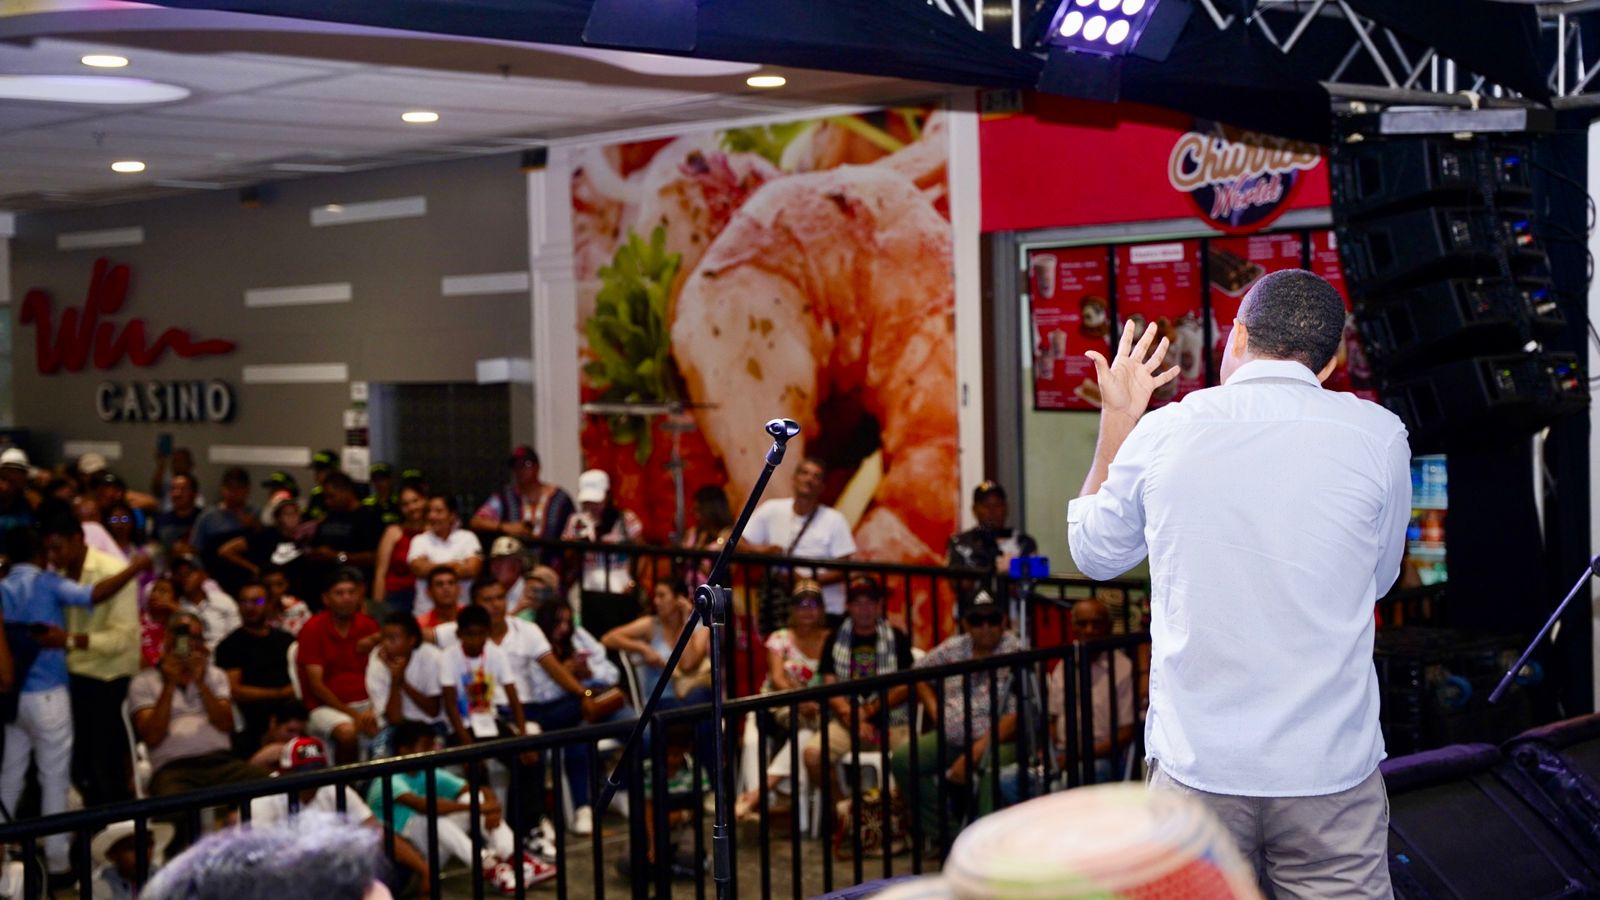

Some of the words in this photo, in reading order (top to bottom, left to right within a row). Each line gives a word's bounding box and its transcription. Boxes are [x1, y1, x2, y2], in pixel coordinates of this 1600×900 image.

[1210, 173, 1283, 219] World
[20, 257, 236, 374] Win
[96, 381, 234, 422] CASINO
